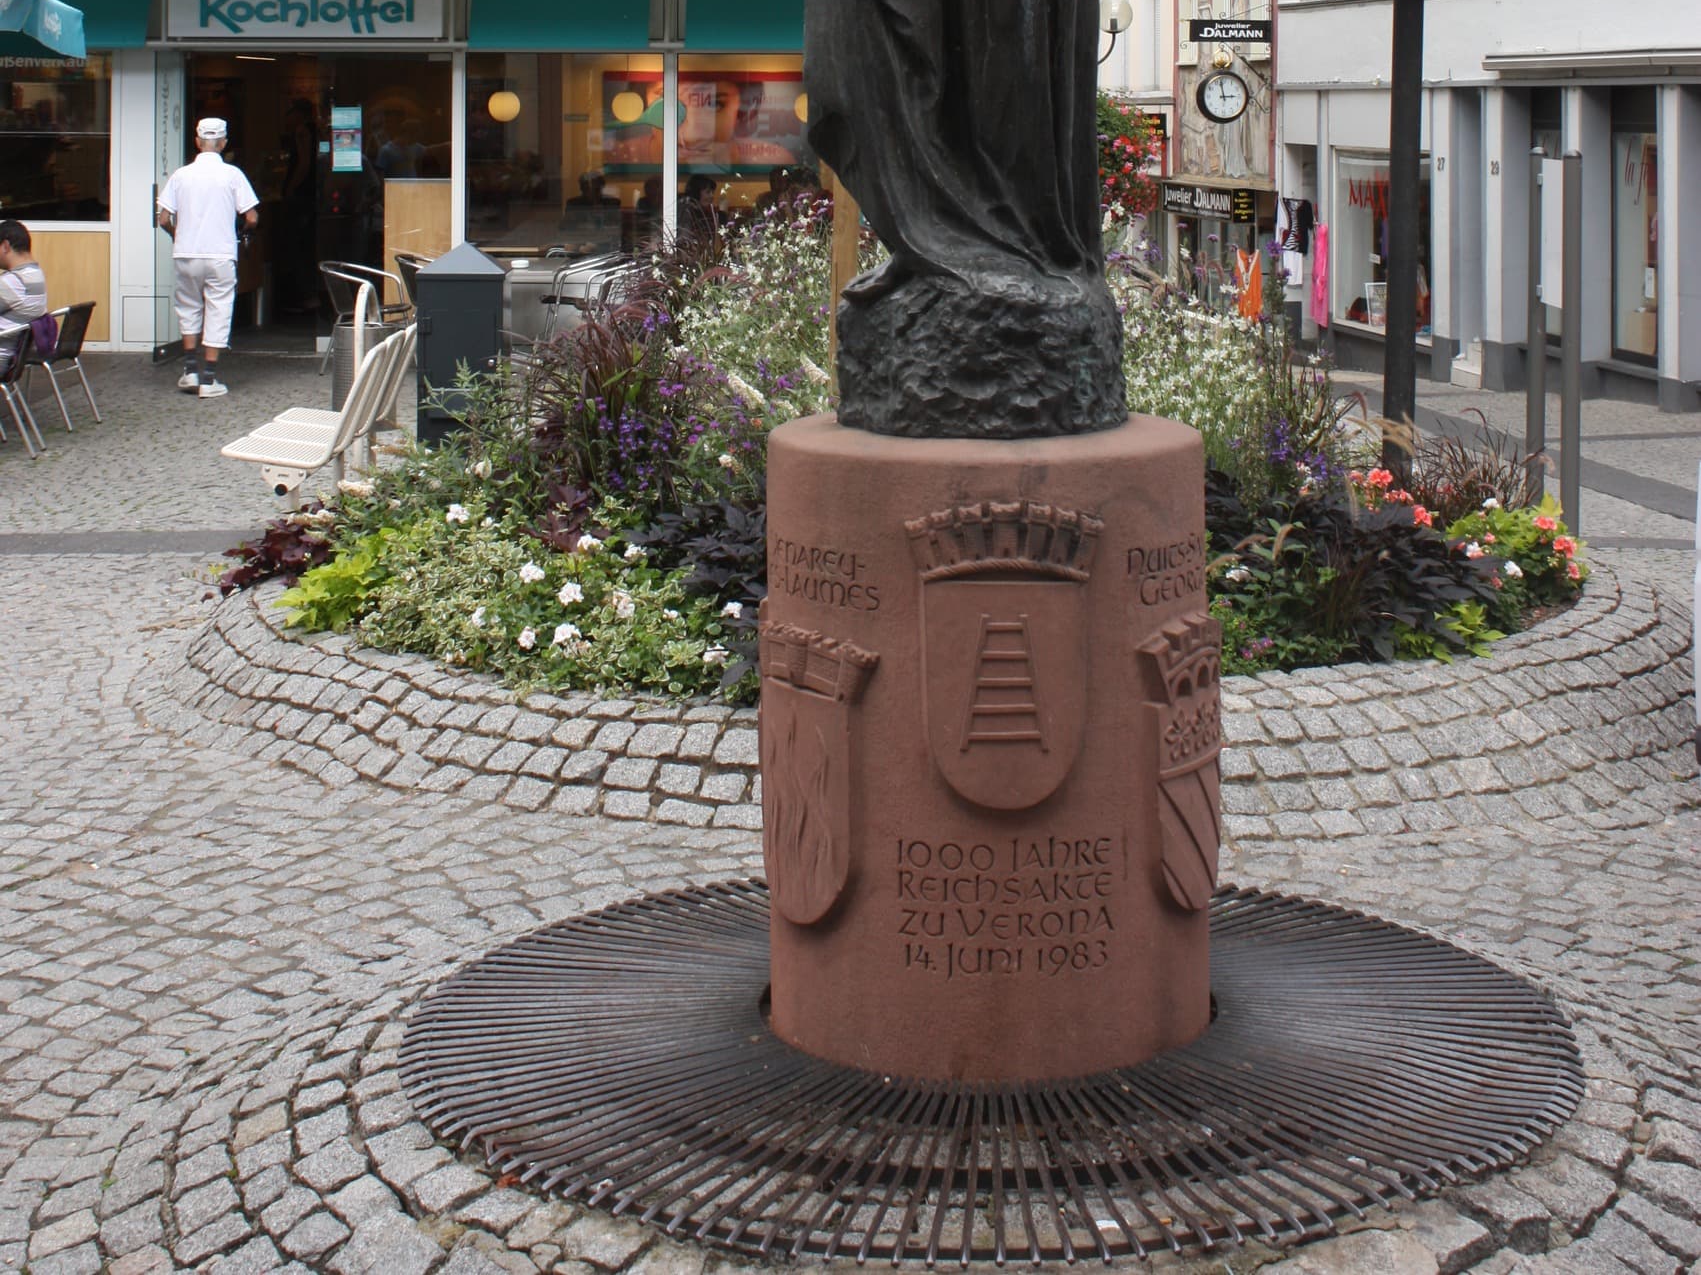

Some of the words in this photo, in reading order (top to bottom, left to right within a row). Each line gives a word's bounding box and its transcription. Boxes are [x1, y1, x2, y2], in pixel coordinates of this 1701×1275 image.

[1199, 27, 1263, 38] DALMANN
[1437, 157, 1445, 171] 27
[1164, 184, 1193, 206] Juwelier
[1193, 187, 1231, 212] DALMANN
[897, 838, 994, 871] 1000
[898, 908, 945, 937] ZU
[956, 904, 1115, 939] VERONA
[905, 942, 937, 971] 14.
[1036, 940, 1108, 976] 1983
